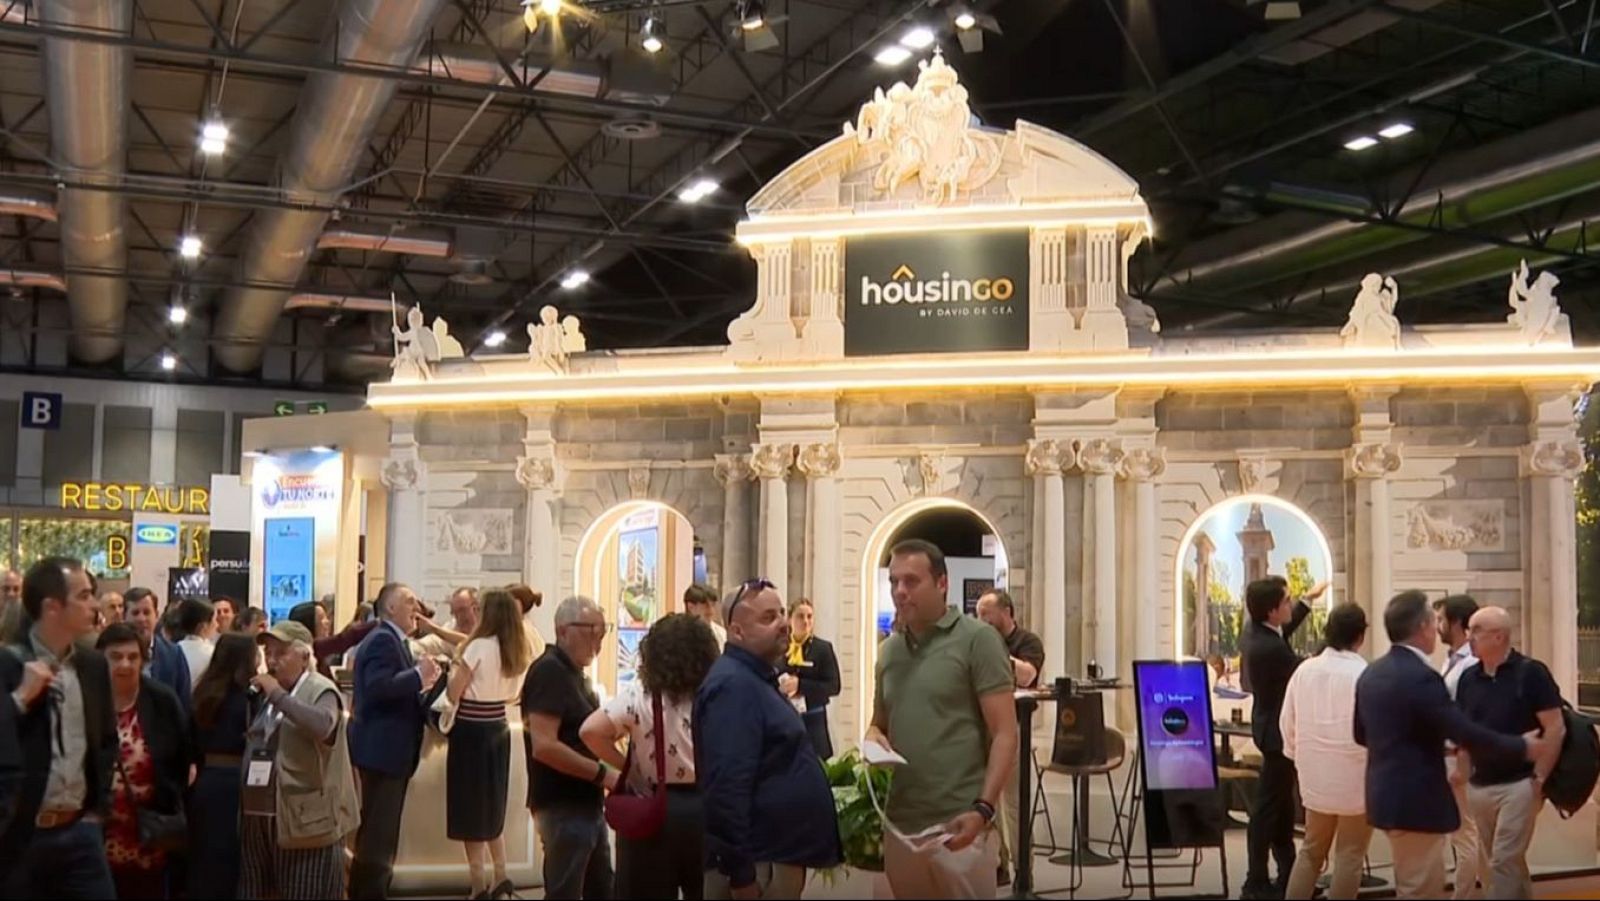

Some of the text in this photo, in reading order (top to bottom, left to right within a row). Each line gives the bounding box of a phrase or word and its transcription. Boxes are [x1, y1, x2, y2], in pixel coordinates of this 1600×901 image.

[919, 306, 1013, 317] BY DAVID DE CEA
[31, 397, 52, 424] B
[61, 482, 209, 513] RESTAUR
